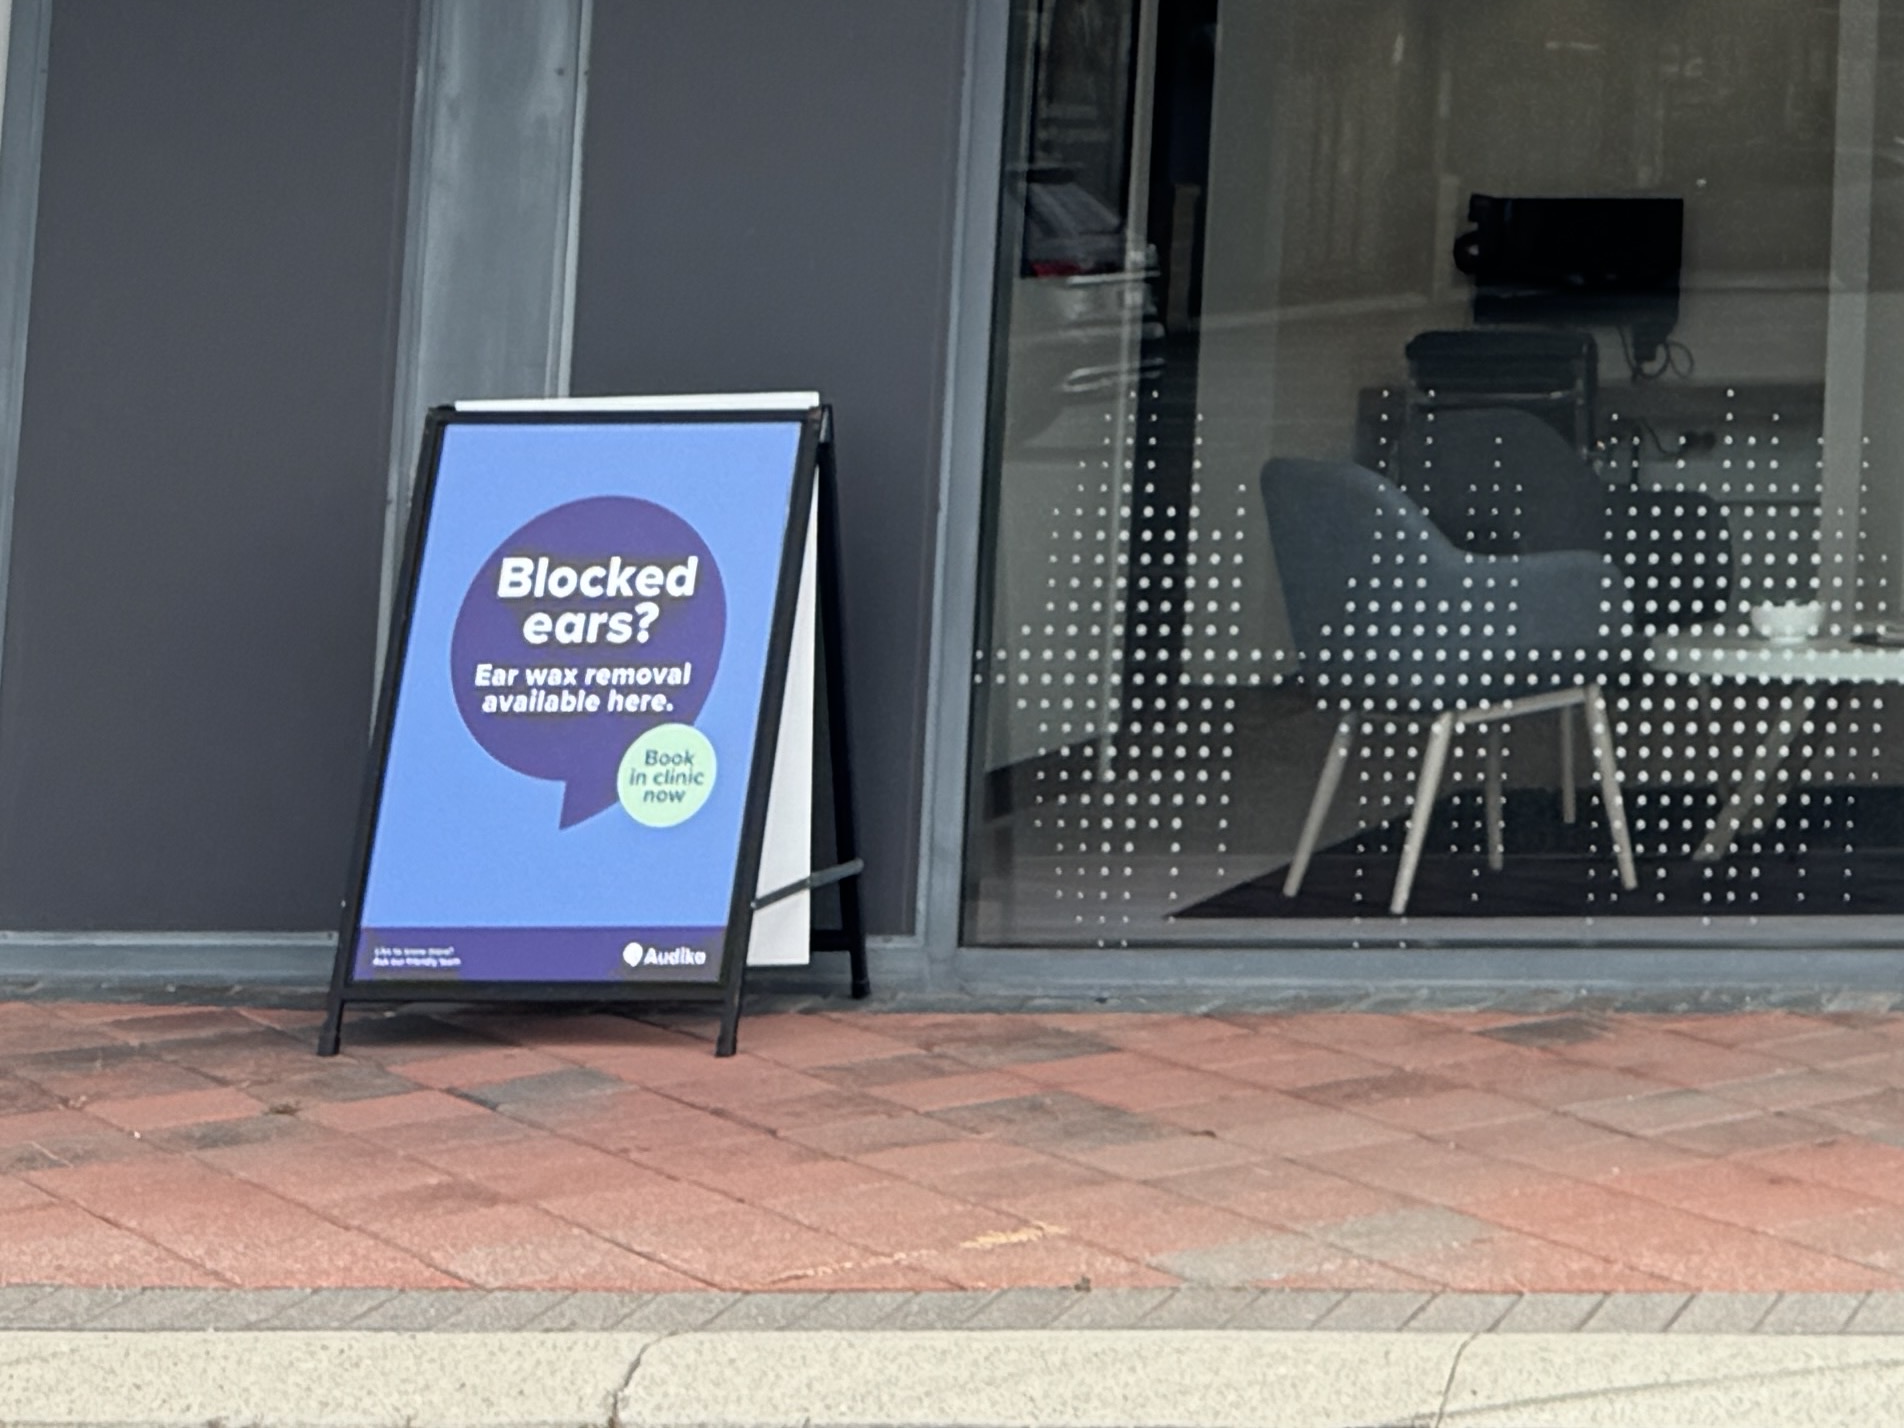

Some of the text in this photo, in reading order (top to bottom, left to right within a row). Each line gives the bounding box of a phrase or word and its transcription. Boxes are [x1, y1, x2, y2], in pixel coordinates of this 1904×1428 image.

[497, 555, 699, 598] Blocked
[522, 602, 660, 645] ears?
[475, 662, 691, 688] Ear wax removal
[481, 687, 674, 714] available here.
[644, 748, 694, 768] Book
[628, 766, 705, 788] in clinic
[643, 787, 686, 805] now
[643, 947, 707, 966] Audika
